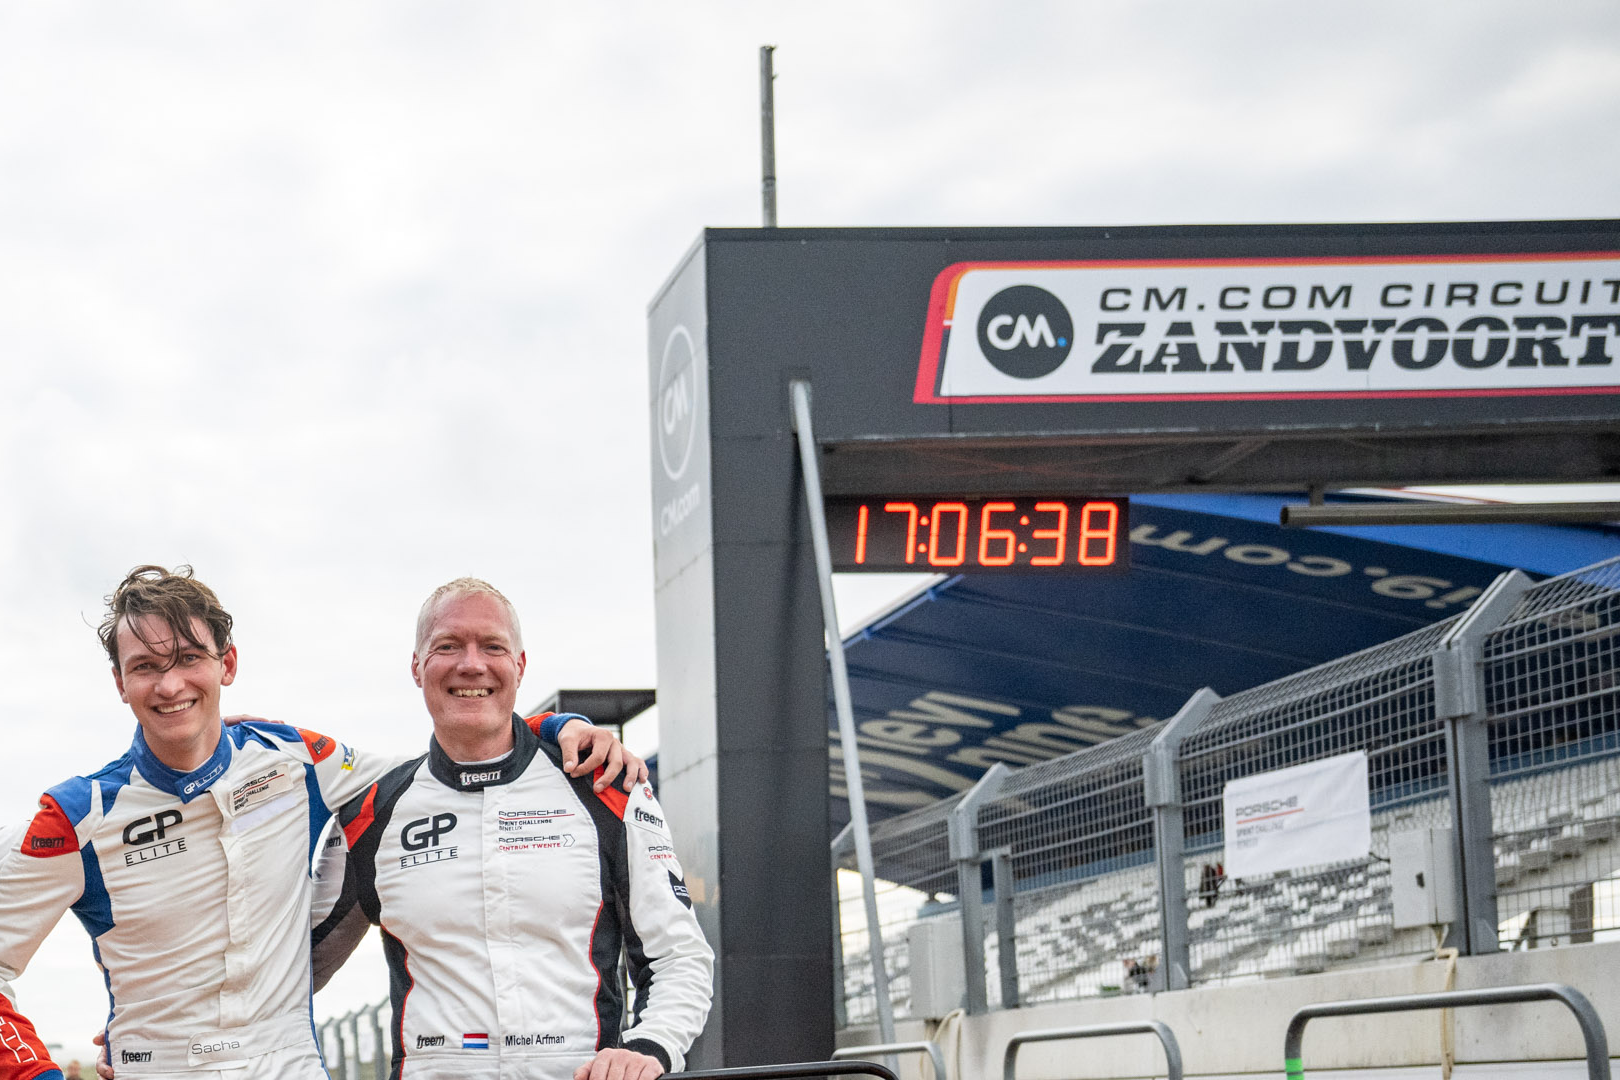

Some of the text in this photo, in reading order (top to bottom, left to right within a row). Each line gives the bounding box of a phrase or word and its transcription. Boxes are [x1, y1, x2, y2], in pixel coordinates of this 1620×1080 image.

[1099, 284, 1354, 312] CM.COM
[1090, 314, 1620, 374] ZANDVOORT
[854, 501, 1120, 567] 17:06:38
[459, 769, 502, 786] freem
[498, 808, 567, 818] PORSCHE
[634, 806, 664, 829] freem
[1235, 795, 1299, 817] PORSCHE
[123, 809, 184, 846] GP
[400, 812, 458, 851] GP
[124, 838, 188, 867] ELITE
[532, 842, 562, 850] TWENTE
[399, 846, 459, 870] ELITE
[191, 1040, 241, 1055] Sacha
[505, 1034, 565, 1047] Michel Arfman
[121, 1049, 152, 1065] freem
